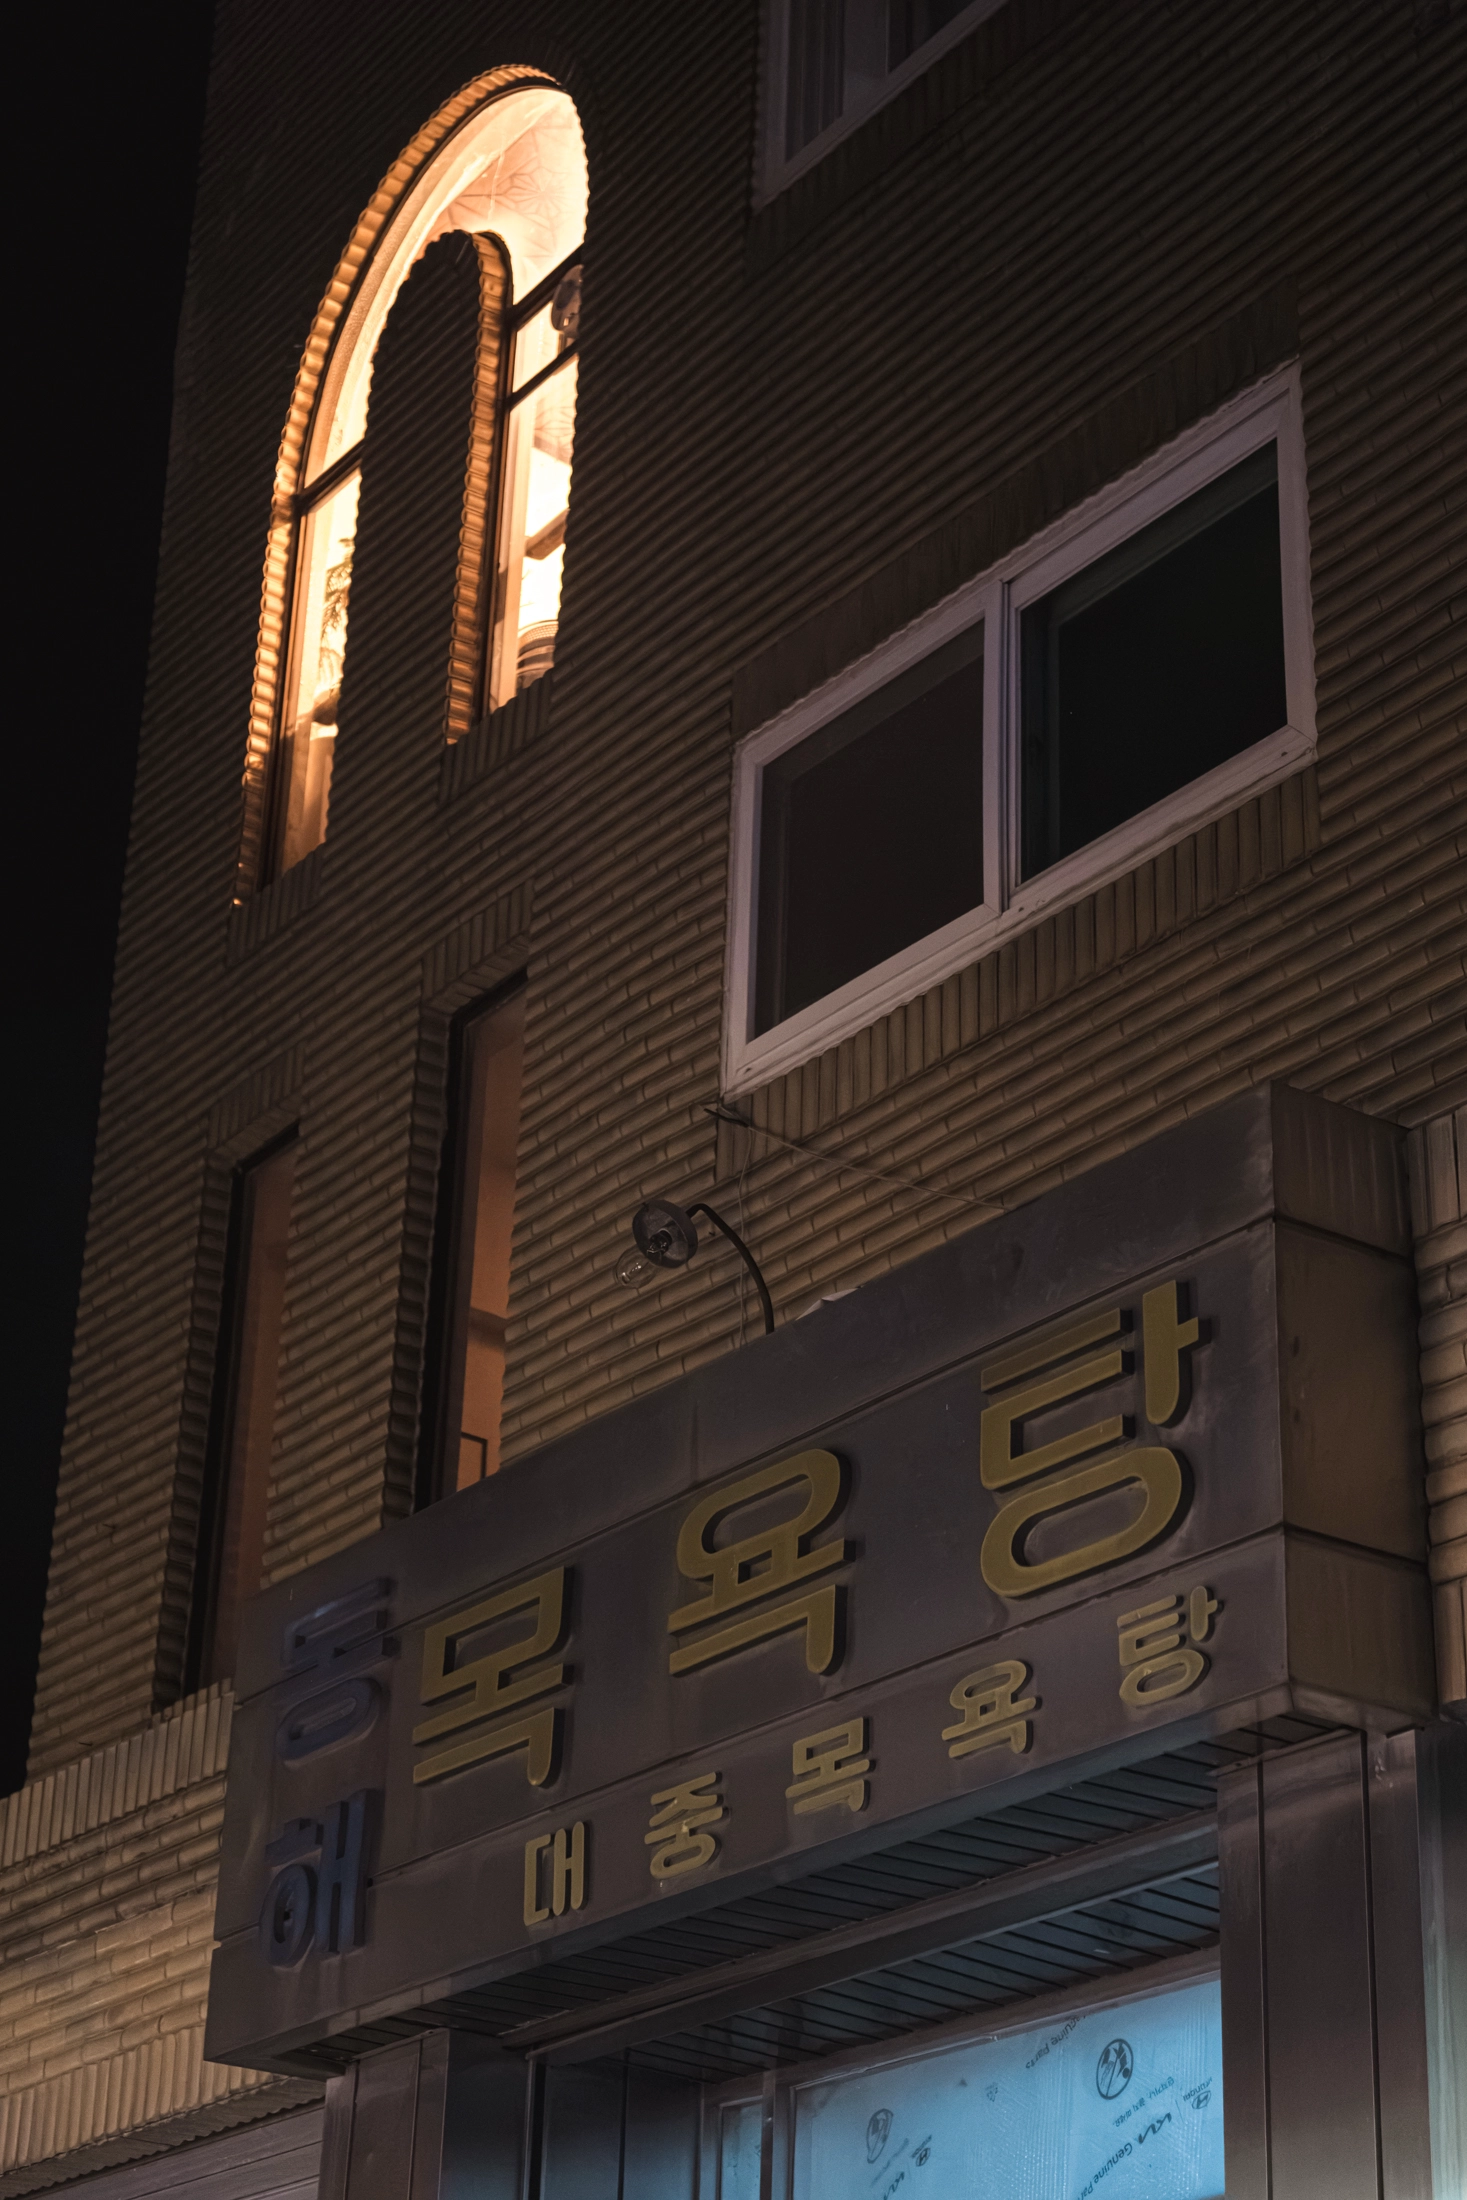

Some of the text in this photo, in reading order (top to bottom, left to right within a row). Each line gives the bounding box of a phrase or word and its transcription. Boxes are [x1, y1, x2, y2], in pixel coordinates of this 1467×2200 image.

[413, 1280, 1211, 1787] 목욕탕
[259, 1577, 396, 1970] 동해
[522, 1584, 1222, 1927] 대중목욕탕
[1094, 2142, 1133, 2184] Genuine
